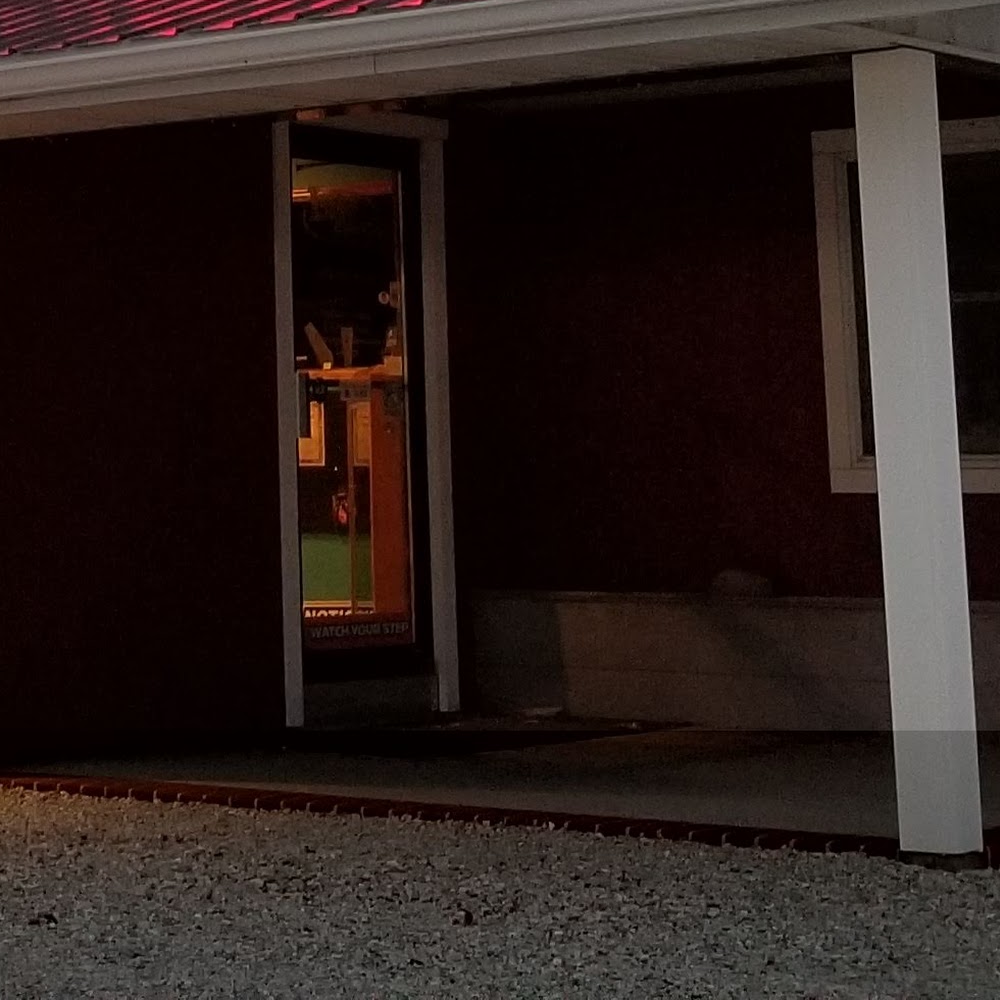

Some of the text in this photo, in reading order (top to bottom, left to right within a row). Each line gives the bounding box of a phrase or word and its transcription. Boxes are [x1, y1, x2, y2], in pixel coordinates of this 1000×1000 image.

[312, 621, 409, 638] WATCH YOUR STEP
